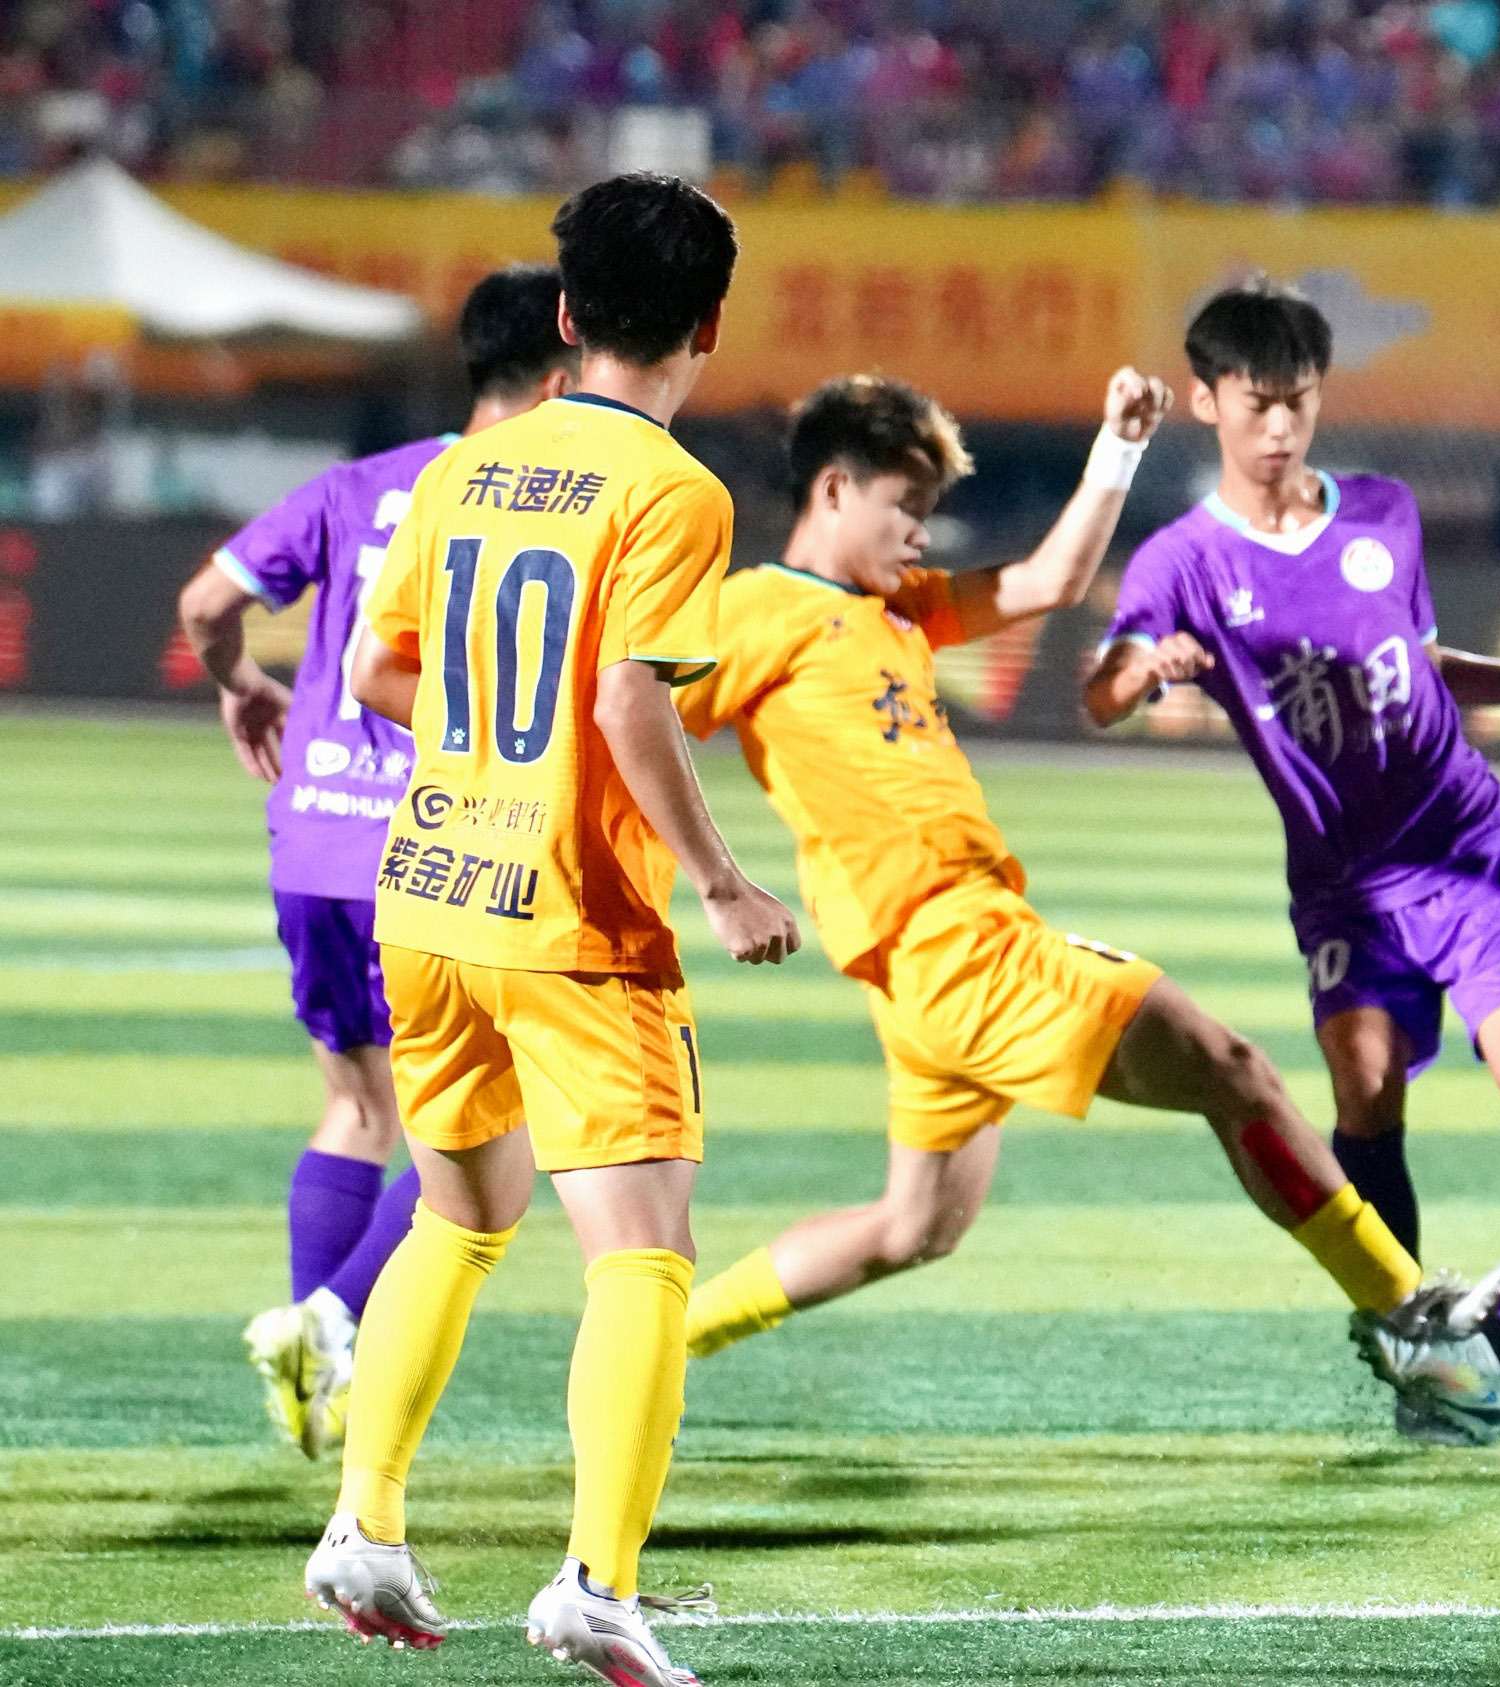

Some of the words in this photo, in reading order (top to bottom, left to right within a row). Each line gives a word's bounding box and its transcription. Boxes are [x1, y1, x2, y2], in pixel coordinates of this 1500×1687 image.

[460, 462, 608, 516] 朱逸涛
[440, 535, 577, 765] 10
[377, 836, 540, 921] 紫金矿业
